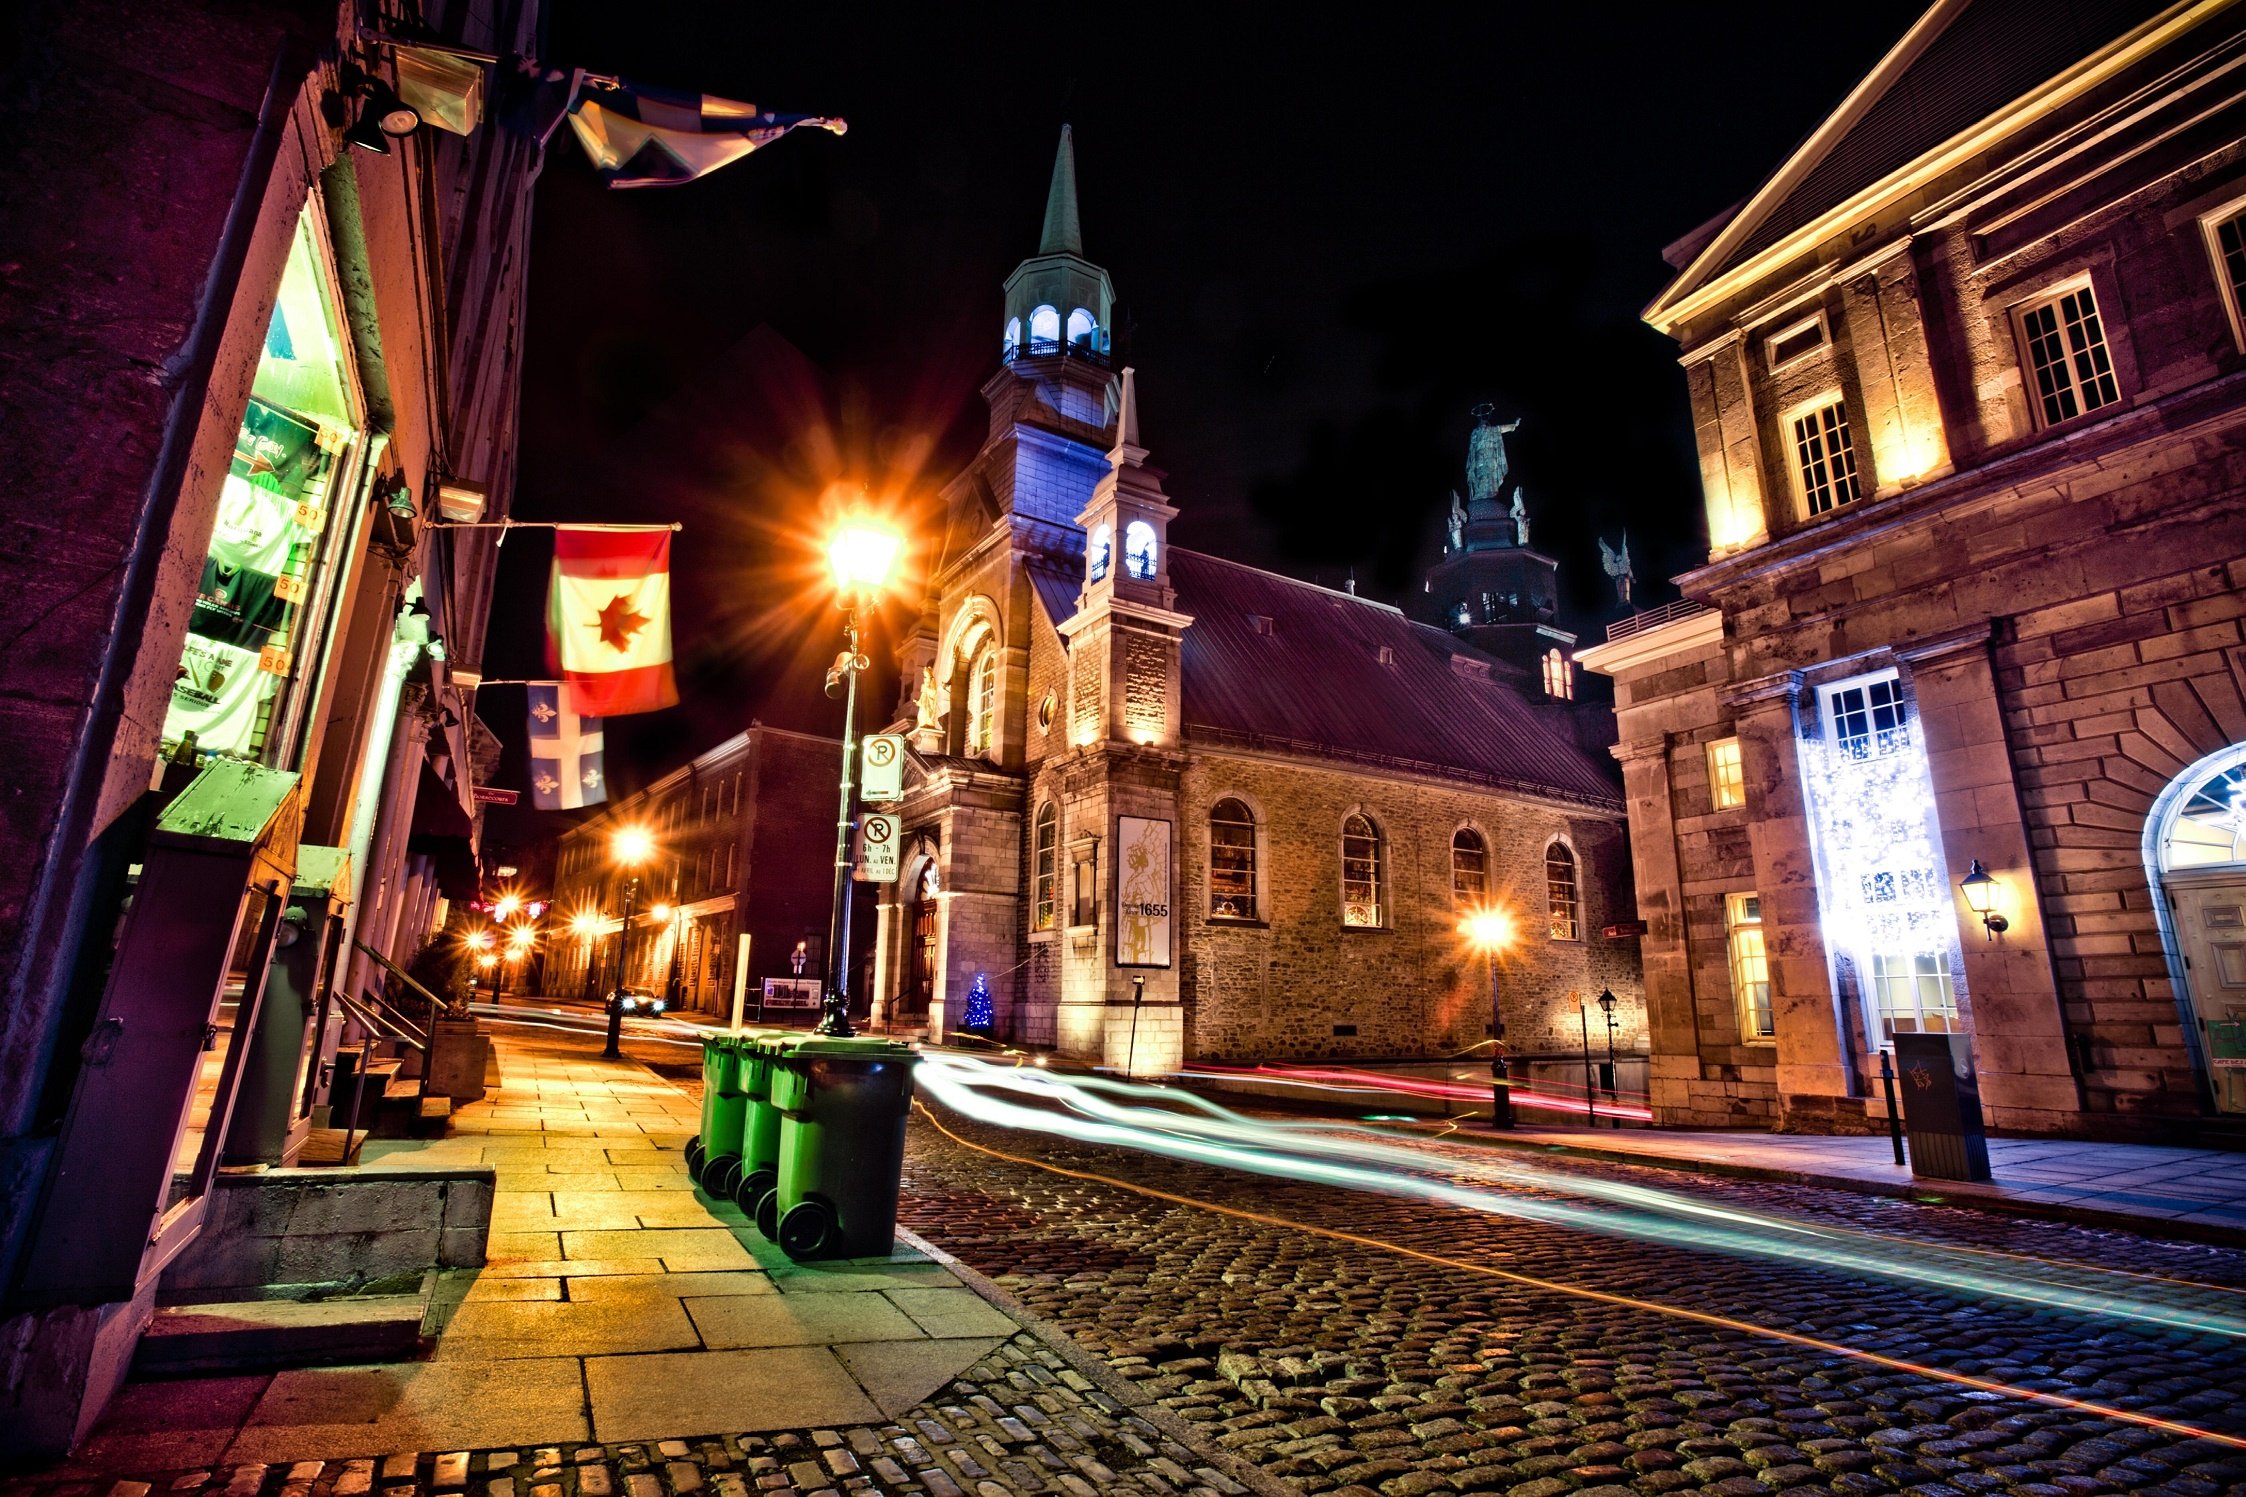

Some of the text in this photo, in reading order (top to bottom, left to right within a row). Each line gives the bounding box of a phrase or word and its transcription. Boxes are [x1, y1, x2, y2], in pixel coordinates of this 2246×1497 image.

[298, 505, 318, 520] 50
[280, 579, 299, 594] 50
[174, 683, 221, 704] ASEBALL
[862, 844, 872, 852] 6h
[882, 844, 891, 853] 7h
[880, 856, 896, 865] VEN.
[1139, 903, 1168, 917] 1655
